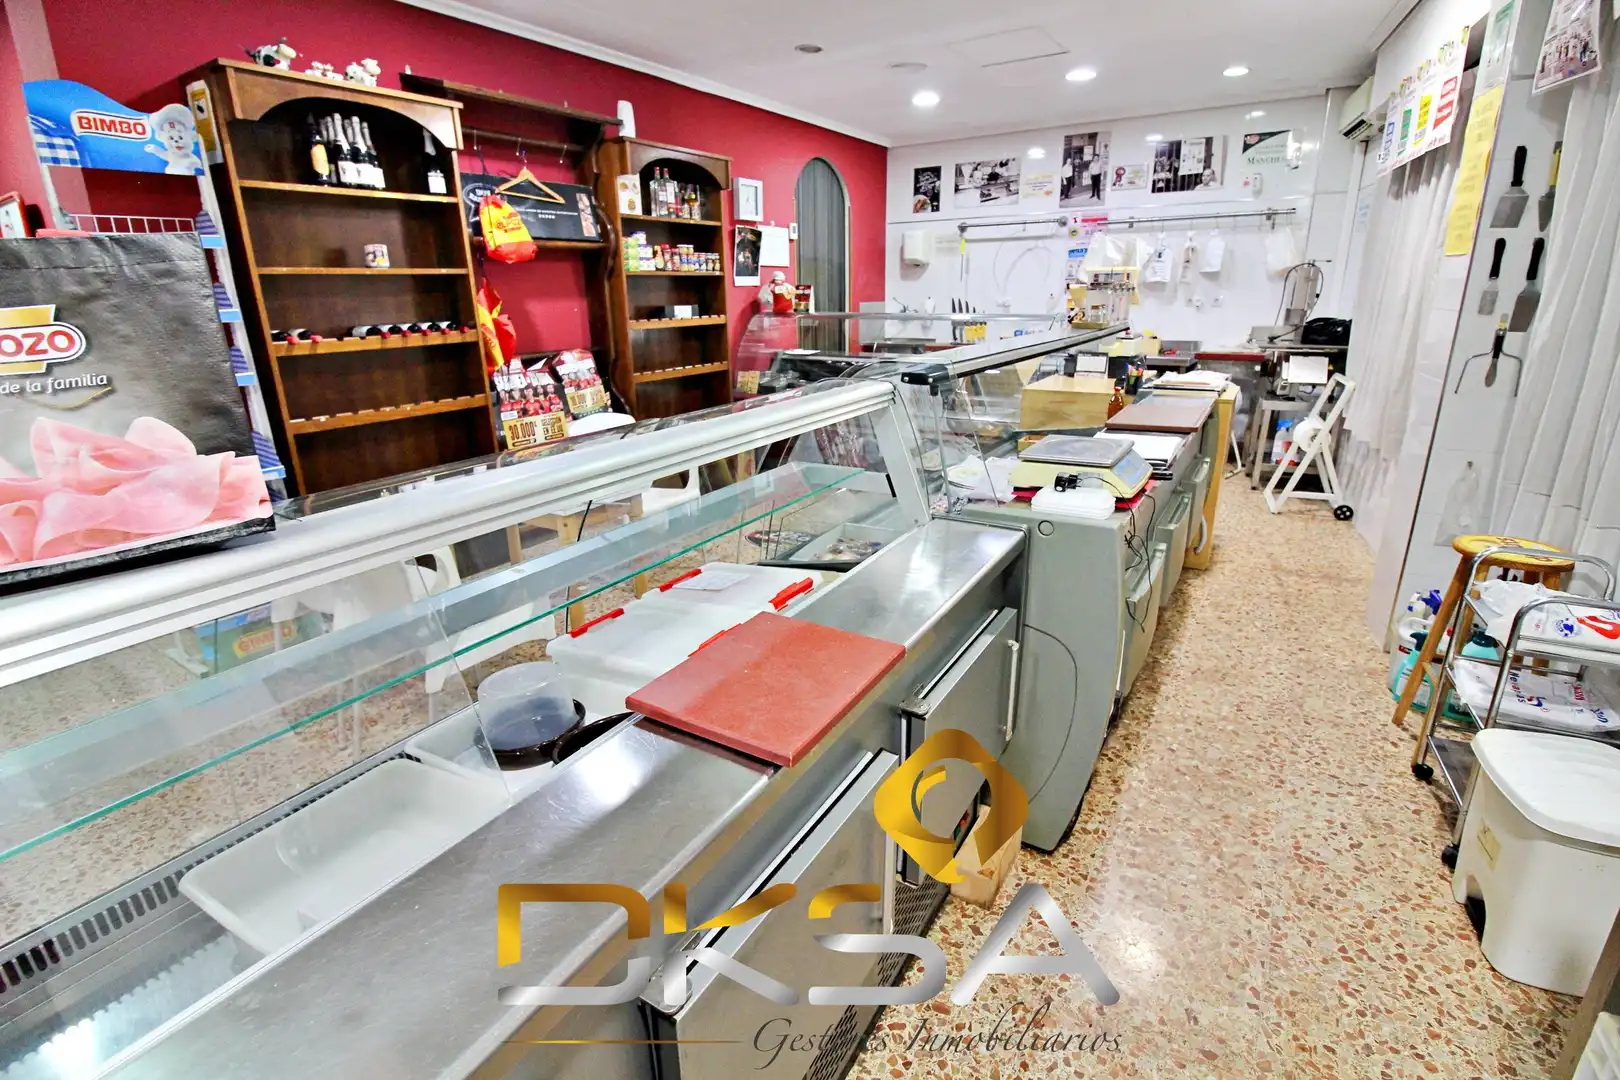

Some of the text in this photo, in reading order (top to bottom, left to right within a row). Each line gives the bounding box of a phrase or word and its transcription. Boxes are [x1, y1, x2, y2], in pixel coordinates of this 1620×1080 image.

[77, 115, 147, 136] BIMBO
[0, 330, 76, 357] OZO
[0, 373, 108, 394] de la familia
